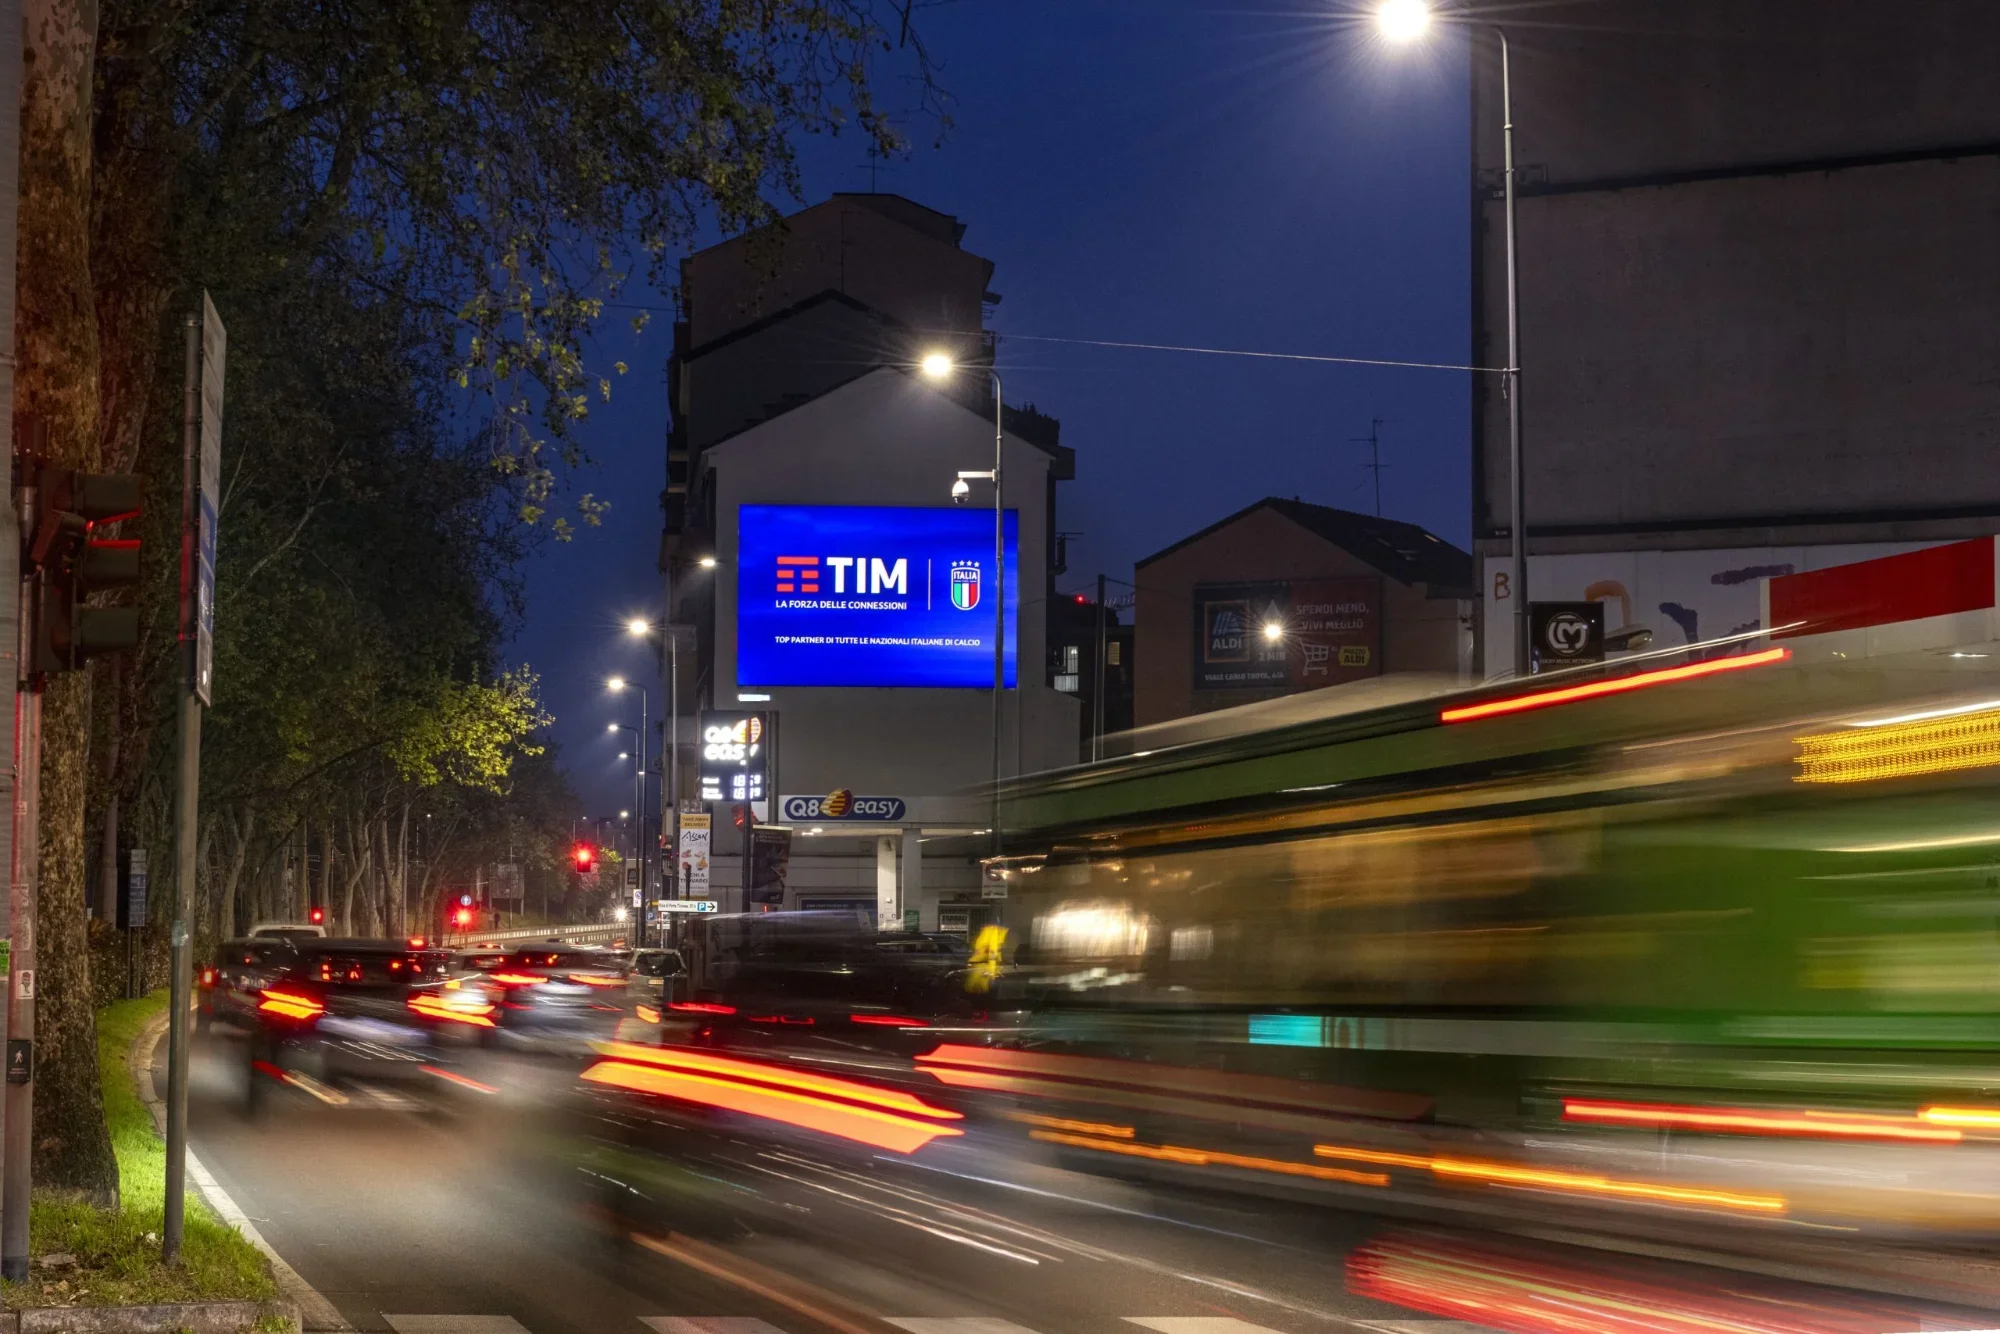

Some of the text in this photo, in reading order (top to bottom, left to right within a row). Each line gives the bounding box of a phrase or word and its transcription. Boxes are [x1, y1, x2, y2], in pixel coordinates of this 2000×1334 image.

[826, 557, 907, 594] TIM
[954, 571, 977, 580] ITALIA
[776, 600, 907, 610] LA FORZA DELLE CONNESSIONI
[1296, 603, 1369, 615] SPENDI MENO,
[1302, 619, 1363, 630] VIVI MEGLIO
[791, 636, 824, 644] PARTNER
[870, 637, 910, 645] NAZIONALI
[911, 638, 943, 646] ITALIANE
[945, 638, 953, 646] DI
[1212, 638, 1242, 649] ALDI
[1344, 655, 1364, 663] ALDI
[790, 799, 899, 818] Q8 easy
